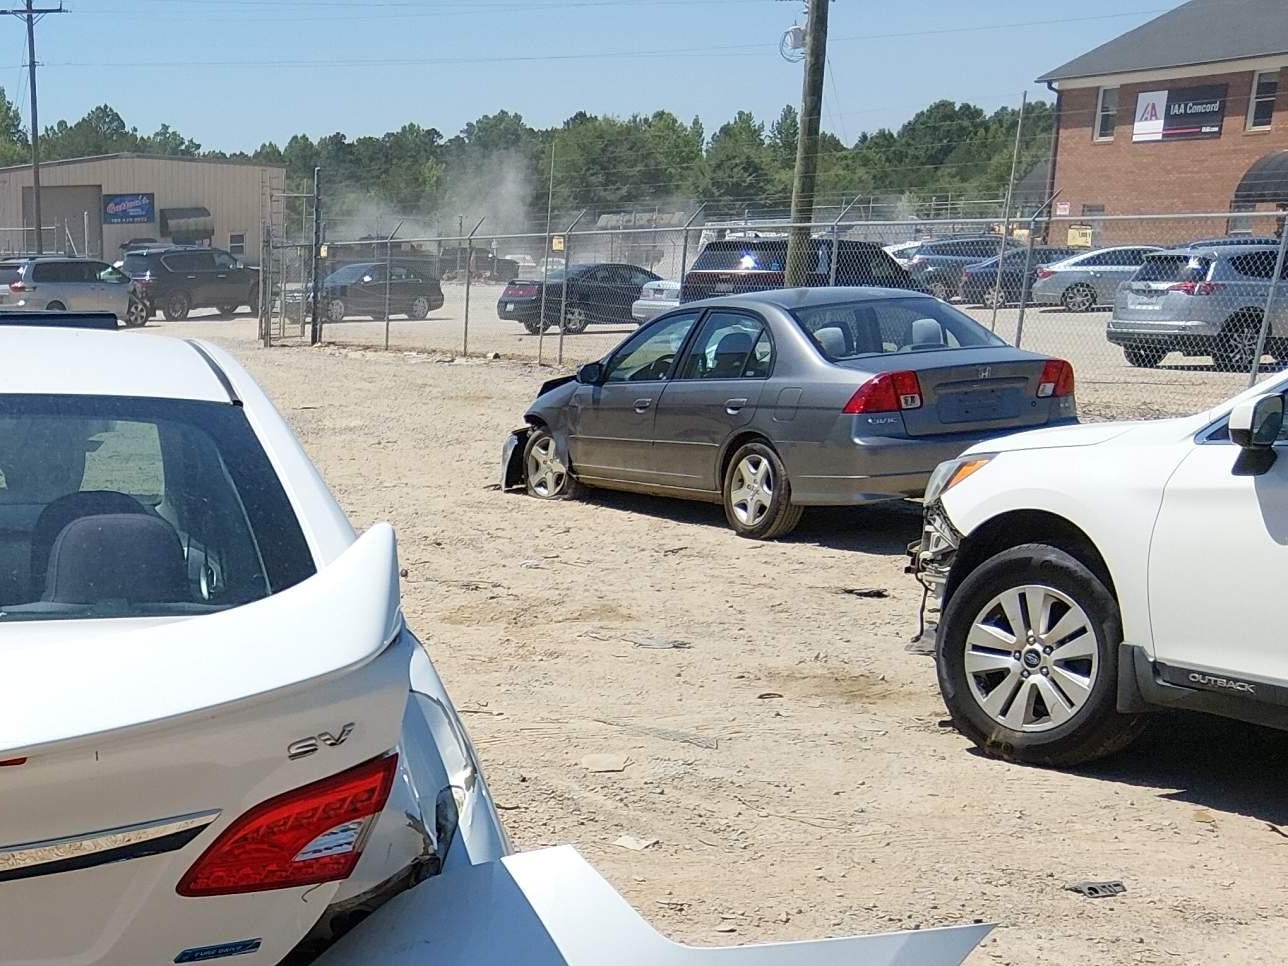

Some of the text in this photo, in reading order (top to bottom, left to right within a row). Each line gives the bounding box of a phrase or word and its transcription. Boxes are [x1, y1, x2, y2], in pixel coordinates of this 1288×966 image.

[1170, 100, 1220, 115] IAA Concord
[1188, 673, 1256, 695] OUTBACK
[288, 722, 355, 760] SV
